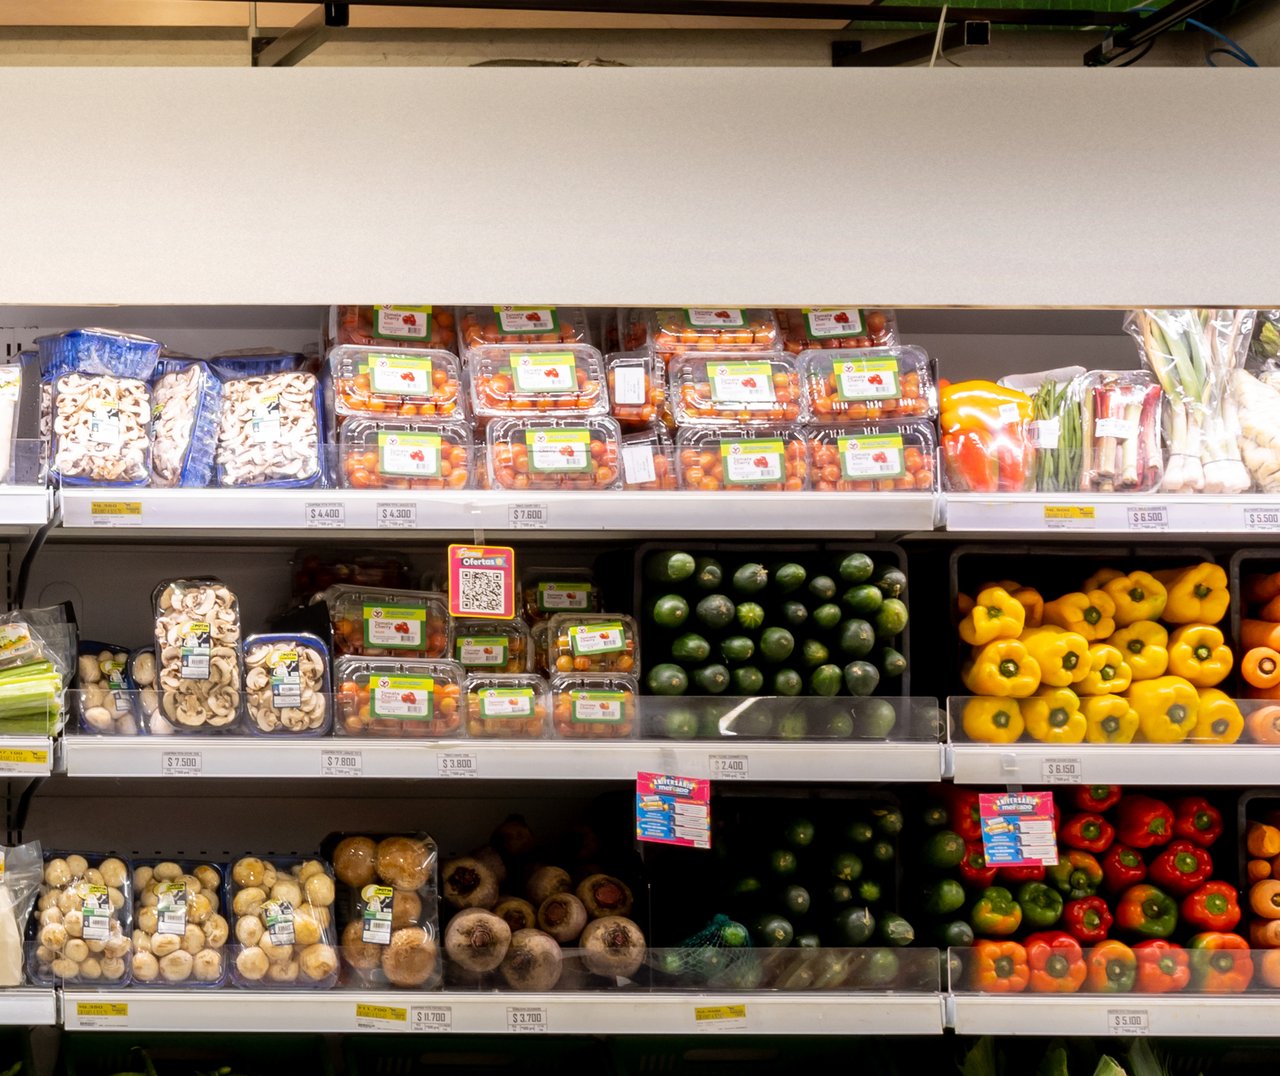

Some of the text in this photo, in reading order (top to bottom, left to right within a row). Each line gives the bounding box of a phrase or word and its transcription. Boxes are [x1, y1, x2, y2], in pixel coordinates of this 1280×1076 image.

[317, 508, 340, 519] 4.400
[389, 508, 412, 519] 4.300
[520, 509, 543, 520] 7.600
[1140, 512, 1163, 522] 6.500
[462, 557, 495, 567] Ofertas
[174, 757, 197, 767] 7.500
[334, 757, 357, 767] 7.800
[450, 759, 472, 768] 3.800
[721, 760, 743, 770] 2.400
[424, 1011, 446, 1022] 11.700
[520, 1013, 542, 1023] 3.700
[1121, 1016, 1142, 1026] 5.100
